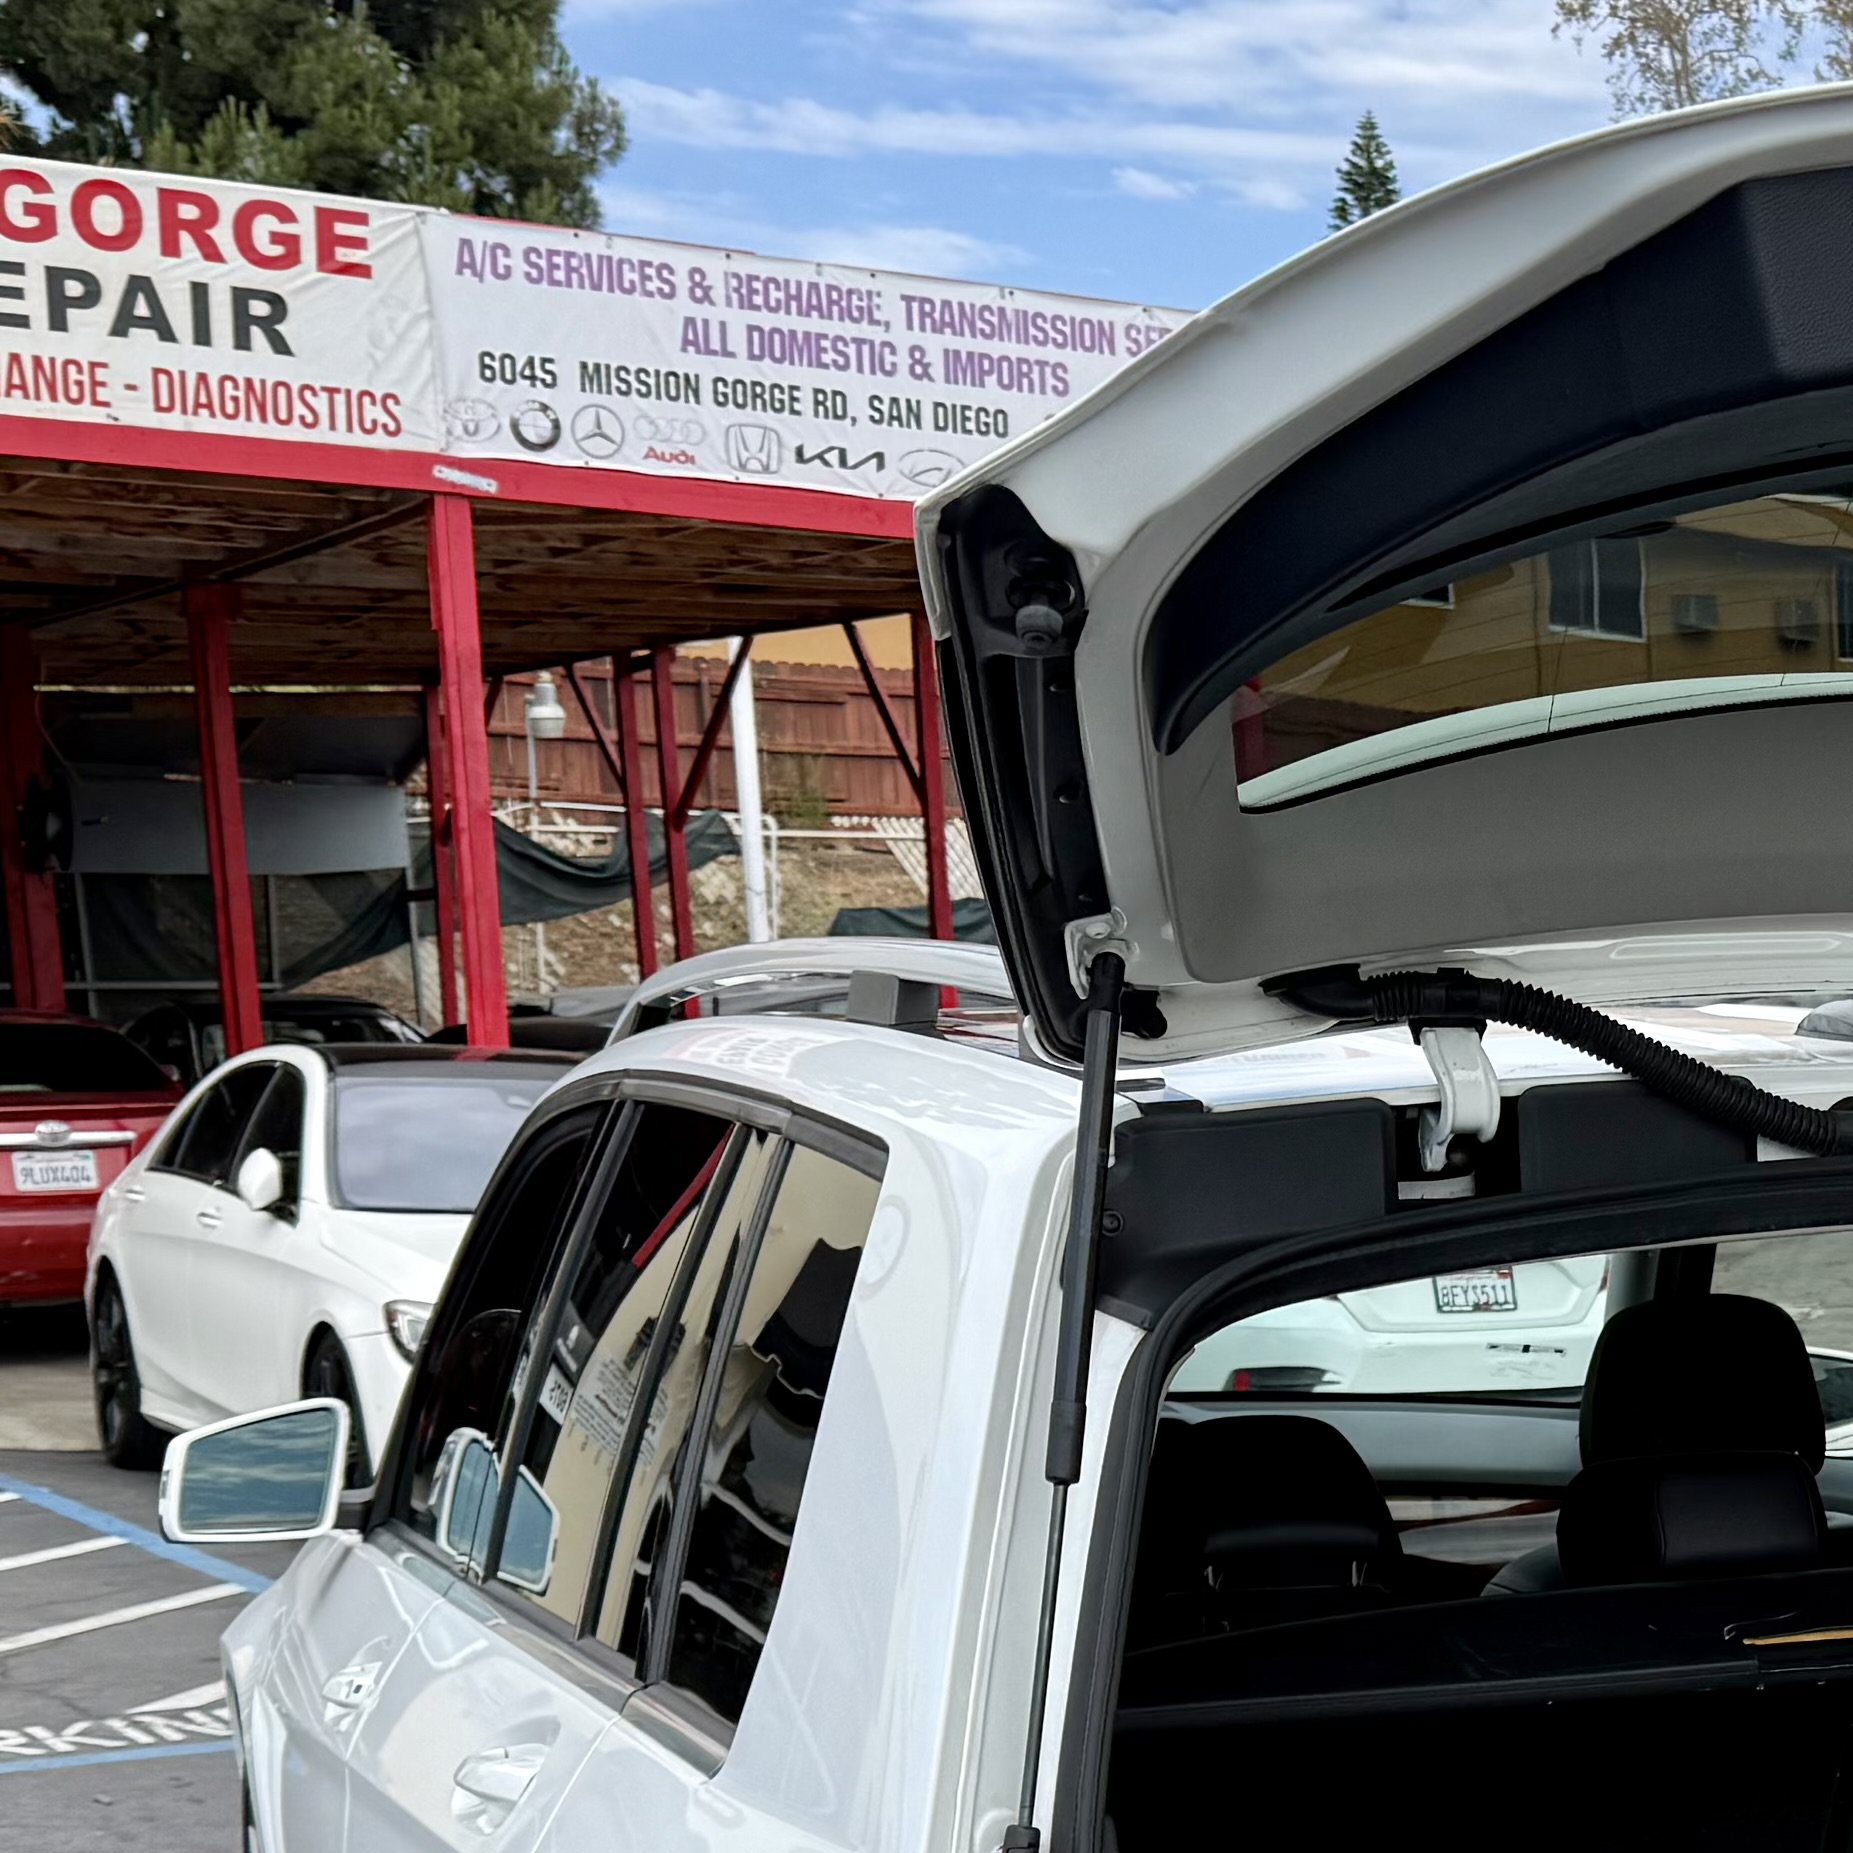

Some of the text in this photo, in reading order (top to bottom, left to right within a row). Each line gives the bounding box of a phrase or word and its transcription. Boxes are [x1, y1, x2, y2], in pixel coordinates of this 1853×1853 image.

[0, 168, 373, 280] GORGE
[455, 237, 512, 283] A/C
[522, 246, 677, 301] SERVICES
[687, 266, 716, 307] &
[723, 270, 892, 333] RECHARGE,
[900, 293, 1116, 356] TRANSMISSION
[477, 350, 1009, 439] 6045 MISSION GORGE RD, SAN DIEGO
[680, 315, 1070, 398] ALL DOMESTIC & IMPORTS
[151, 367, 402, 438] DIAGNOSTICS
[642, 445, 697, 466] Audi
